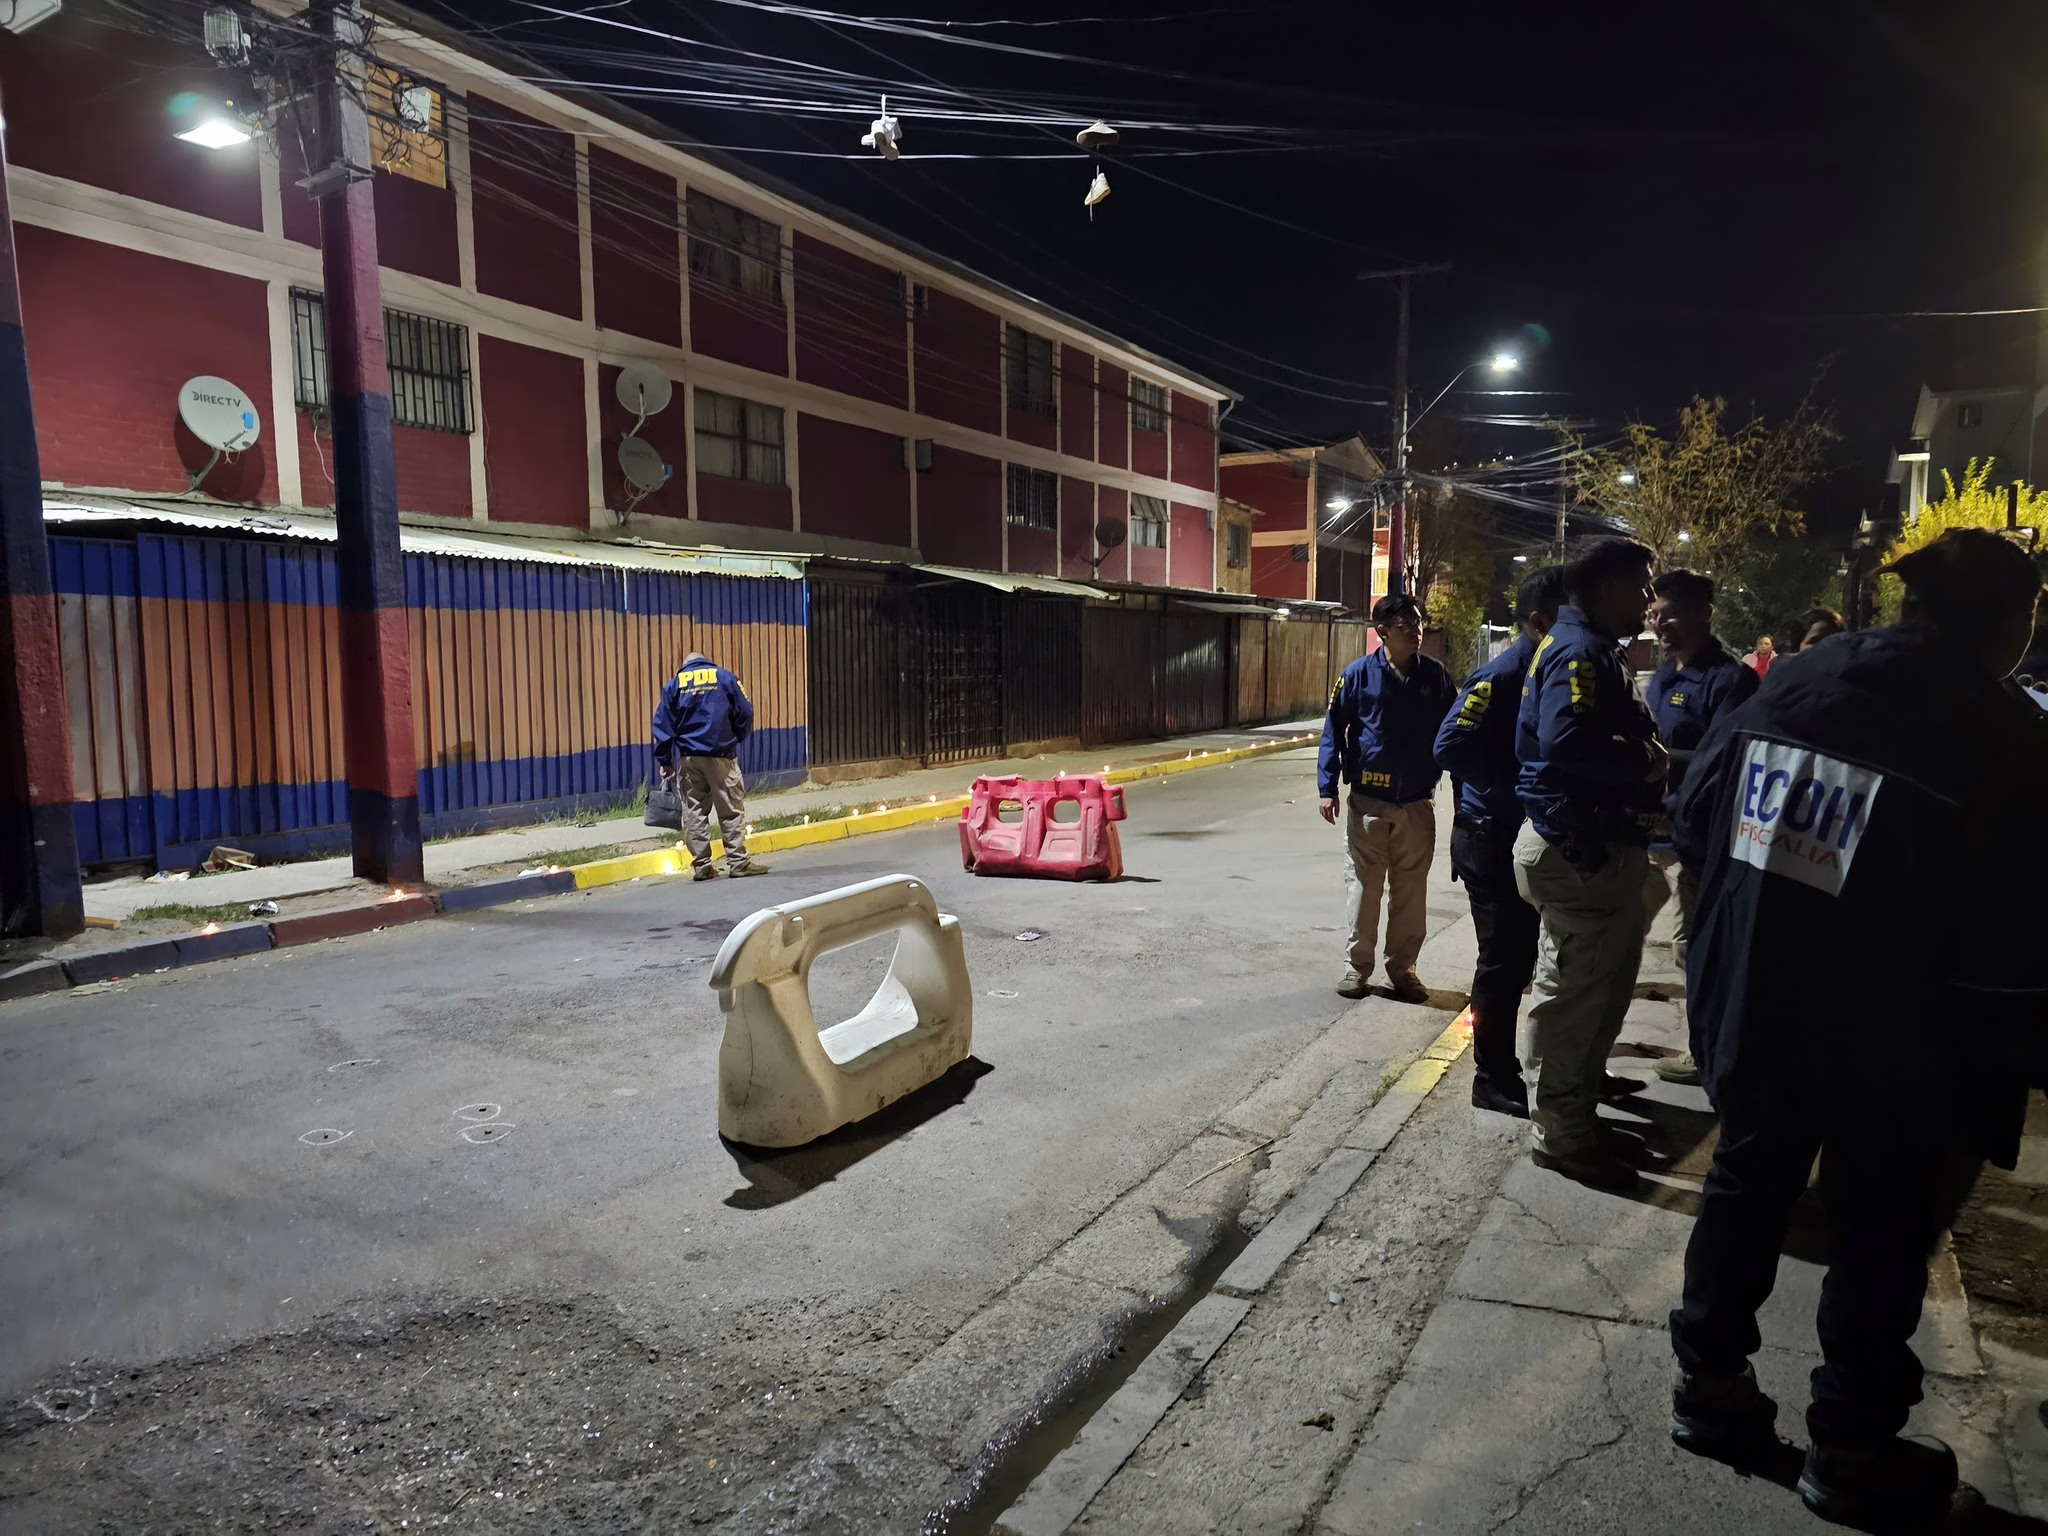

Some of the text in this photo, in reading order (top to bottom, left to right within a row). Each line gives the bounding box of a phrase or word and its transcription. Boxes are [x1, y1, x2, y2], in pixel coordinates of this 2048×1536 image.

[191, 390, 241, 408] DIRECTV
[677, 668, 718, 688] PDI
[1461, 680, 1492, 719] PDI
[1361, 768, 1392, 788] PDI
[1743, 762, 1867, 850] ECOH
[1740, 821, 1839, 870] FISCALIA
